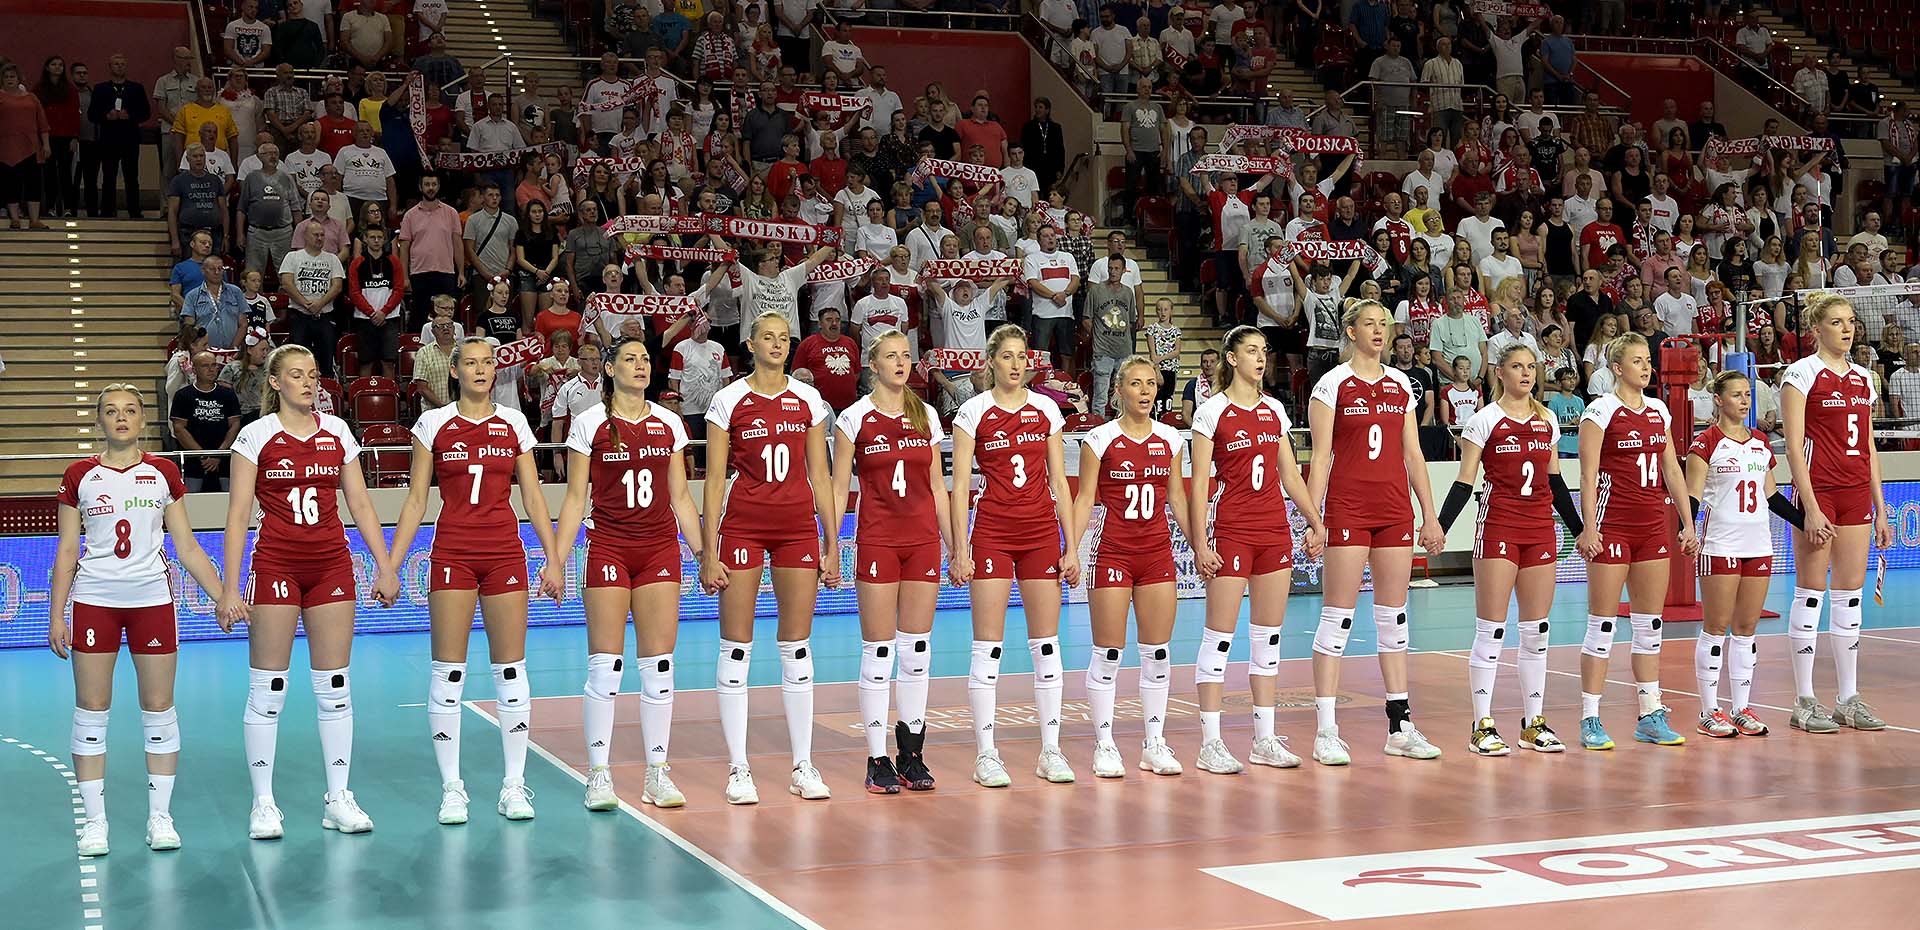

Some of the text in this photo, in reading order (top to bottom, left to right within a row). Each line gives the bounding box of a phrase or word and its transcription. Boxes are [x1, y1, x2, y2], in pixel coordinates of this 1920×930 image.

[809, 95, 873, 108] POLSKA
[1295, 137, 1353, 151] POLSKA
[930, 159, 1000, 182] POLSKA
[1211, 158, 1273, 169] POL SKA
[629, 219, 659, 229] POL
[735, 220, 811, 241] POLSKA
[1292, 240, 1364, 259] POLSKA
[1399, 239, 1406, 253] 8
[662, 249, 724, 262] DOMINIK
[936, 259, 1021, 277] POLSKA
[364, 280, 390, 288] LEGACY
[596, 294, 692, 314] POLSKA
[821, 346, 850, 354] POLSKA
[1376, 402, 1401, 415] plus
[1453, 399, 1476, 407] POLSKA
[776, 419, 802, 434] plus
[1847, 413, 1859, 448] 5
[743, 431, 767, 439] ORLEN
[1016, 432, 1040, 445] plus
[1257, 431, 1278, 445] plus
[1368, 424, 1383, 460] 9
[866, 445, 890, 454] ORLEN
[897, 437, 923, 450] plus
[986, 440, 1009, 449] ORLEN
[1228, 440, 1251, 451] ORLEN
[1528, 440, 1552, 452] plus
[1619, 439, 1641, 447] ORLEN
[443, 452, 468, 460] ORLEN
[479, 445, 508, 458] plus
[603, 453, 629, 461] ORLEN
[639, 445, 668, 458] plus
[761, 443, 790, 483] 10
[1010, 453, 1027, 488] 3
[1144, 463, 1171, 477] plus
[1635, 453, 1658, 488] 14
[1747, 462, 1766, 473] plus
[267, 469, 294, 477] ORLEN
[305, 464, 333, 478] plus
[891, 459, 907, 498] 4
[1251, 454, 1264, 491] 6
[1520, 461, 1535, 496] 2
[468, 464, 483, 505] 7
[621, 468, 653, 509] 18
[124, 496, 154, 511] plus
[1124, 483, 1155, 520] 20
[1735, 479, 1757, 514] 13
[88, 506, 113, 516] ORLEN
[287, 487, 319, 526] 16
[114, 518, 131, 560] 8
[1499, 541, 1506, 555] 2
[1608, 543, 1622, 558] 14
[733, 548, 748, 565] 10
[1233, 555, 1240, 572] 6
[1725, 556, 1737, 570] 13
[602, 564, 617, 582] 18
[869, 561, 878, 578] 4
[985, 558, 994, 574] 3
[443, 567, 451, 584] 7
[272, 580, 288, 599] 16
[86, 628, 96, 647] 8
[1538, 825, 1920, 877] ORLE
